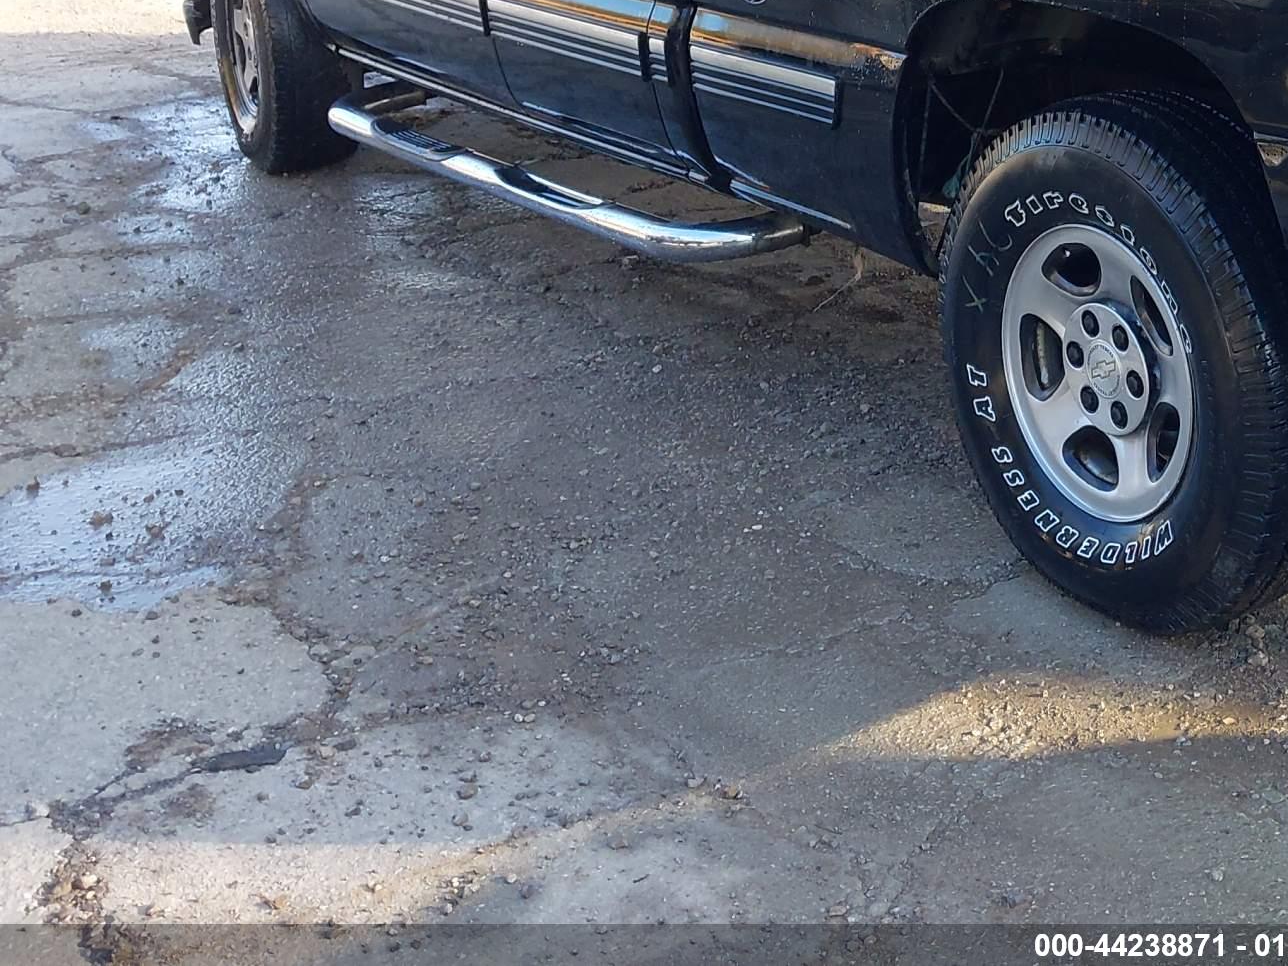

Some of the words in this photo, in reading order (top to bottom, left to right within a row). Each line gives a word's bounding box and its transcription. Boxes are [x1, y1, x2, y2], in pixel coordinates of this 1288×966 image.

[1004, 190, 1193, 355] Firestone
[966, 363, 997, 423] AT
[991, 445, 1174, 565] WILDERNESS
